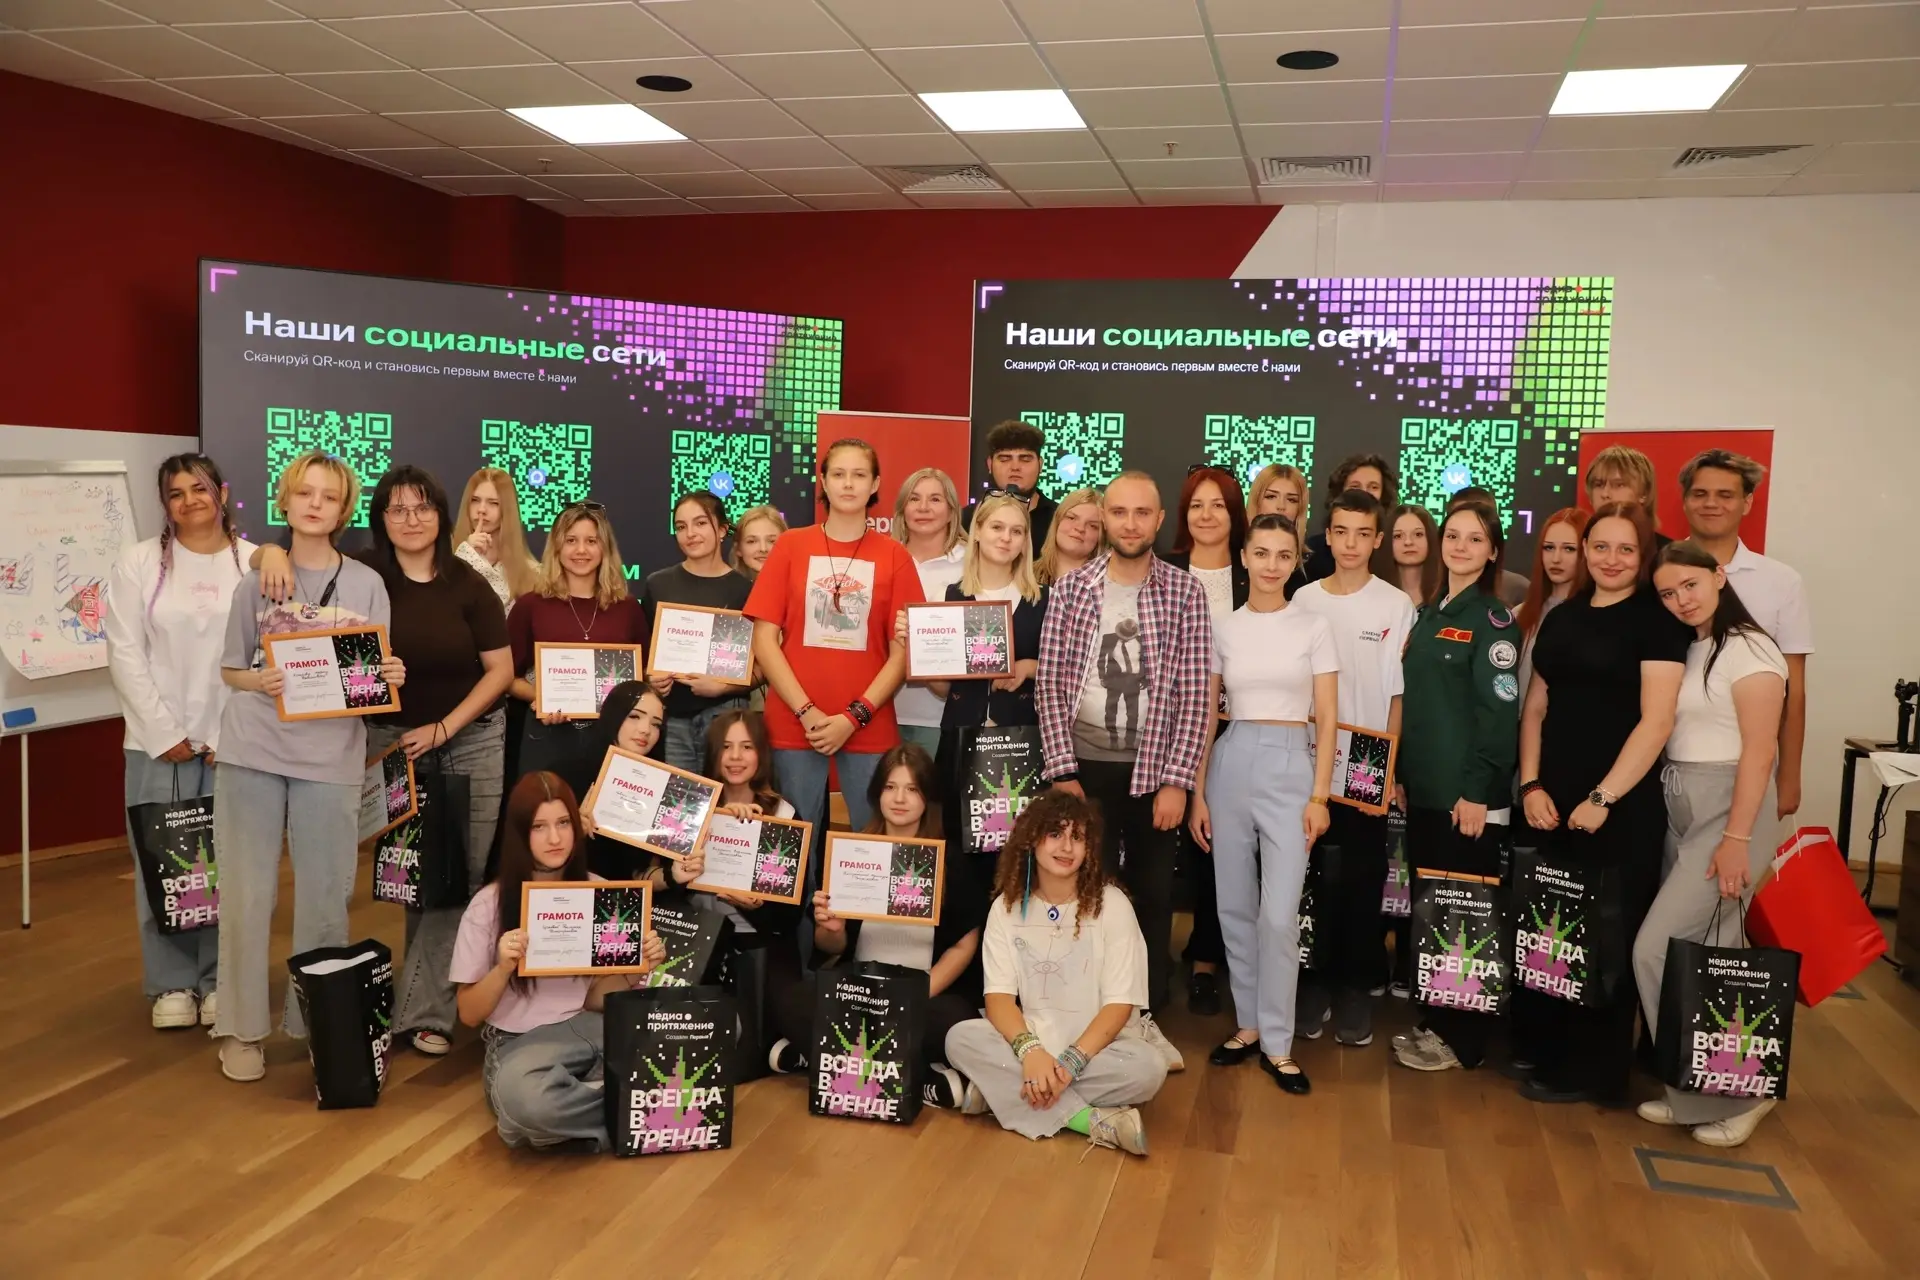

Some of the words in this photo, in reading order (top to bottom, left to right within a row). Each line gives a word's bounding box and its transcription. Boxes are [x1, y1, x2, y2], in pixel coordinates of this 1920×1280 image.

[245, 311, 355, 343] Наши
[364, 326, 585, 361] социальные
[592, 345, 666, 367] сети
[1006, 322, 1096, 346] Наши
[1103, 328, 1310, 349] социальные
[1317, 328, 1398, 348] сети
[243, 350, 309, 367] Сканируй
[312, 355, 361, 370] QR-код
[364, 361, 372, 369] и
[375, 361, 440, 375] становись
[443, 366, 490, 379] первым
[494, 371, 535, 381] вместе
[538, 373, 546, 382] с
[547, 374, 577, 384] нами
[1004, 359, 1056, 373] Сканируй
[1058, 360, 1100, 371] QR-код
[1102, 362, 1109, 371] и
[1111, 362, 1169, 371] становись
[1171, 362, 1215, 373] первым
[1218, 363, 1258, 372] вместе
[1262, 363, 1269, 373] с
[1271, 364, 1301, 373] нами
[667, 627, 704, 637] ГРАМОТА
[917, 627, 957, 635] ГРАМОТА
[711, 641, 747, 653] ВСЕГДА
[965, 636, 1005, 645] ВСЕГДА
[966, 646, 973, 654] В
[285, 659, 329, 670] ГРАМОТА
[709, 657, 745, 668] ТРЕНДЕ
[966, 653, 1005, 662] ТРЕНДЕ
[340, 664, 380, 677] ВСЕГД
[548, 667, 588, 675] ГРАМОТА
[342, 677, 350, 686] В
[344, 682, 387, 695] ТРЕНДЕ
[976, 735, 1003, 744] медиа
[976, 742, 1030, 752] притяжение
[1347, 770, 1353, 779] В
[1348, 762, 1384, 778] ВСЕГДА
[612, 777, 654, 797] ГРАМОТА
[1347, 779, 1383, 794] ТРЕНДЕ
[165, 808, 197, 820] медиа
[166, 814, 214, 828] притяжен
[655, 813, 663, 823] В
[971, 816, 983, 832] В
[709, 834, 750, 848] ГРАМОТА
[972, 831, 1010, 848] ТРЕ
[378, 845, 419, 870] ВСЕГДА
[756, 852, 797, 867] ВСЕГДА
[376, 862, 384, 879] В
[756, 861, 763, 871] В
[840, 860, 882, 871] ГРАМОТА
[1536, 865, 1563, 877] медиа
[161, 871, 220, 895] ВСЕГ
[755, 870, 794, 885] ТРЕНДЕ
[890, 875, 933, 888] ВСЕГДА
[1535, 873, 1584, 891] притяжение
[375, 880, 417, 902] ТРЕНДЕ
[890, 885, 897, 894] В
[1435, 888, 1464, 898] медиа
[164, 895, 178, 912] В
[889, 893, 931, 905] ТРЕНДЕ
[1435, 897, 1492, 909] притяжение
[166, 904, 220, 927] ТРЕН
[537, 912, 584, 920] ГРАМОТА
[593, 922, 640, 935] ВСЕГДА
[593, 933, 601, 943] В
[593, 942, 639, 953] ТРЕНДЕ
[1516, 929, 1585, 964] ВСЕГДА
[1515, 946, 1526, 964] В
[1708, 957, 1739, 967] медиа
[1419, 952, 1500, 980] ВСЕГДА
[1708, 967, 1771, 979] притяжение
[1418, 969, 1431, 986] В
[1516, 964, 1583, 1000] ТРЕНДЕ
[1418, 986, 1499, 1012] ТРЕНДЕ
[648, 1012, 682, 1022] медиа
[647, 1021, 715, 1032] притяжение
[1693, 1030, 1781, 1060] ВСЕГДА
[374, 1057, 384, 1077] В
[819, 1052, 900, 1082] ВСЕГДА
[1692, 1050, 1708, 1070] В
[818, 1072, 831, 1091] В
[1692, 1070, 1779, 1097] ТРЕНДЕ
[630, 1086, 723, 1111] ВСЕГДА
[818, 1091, 899, 1118] ТРЕНДЕ
[629, 1109, 645, 1129] В
[630, 1124, 721, 1149] ТРЕНДЕ
